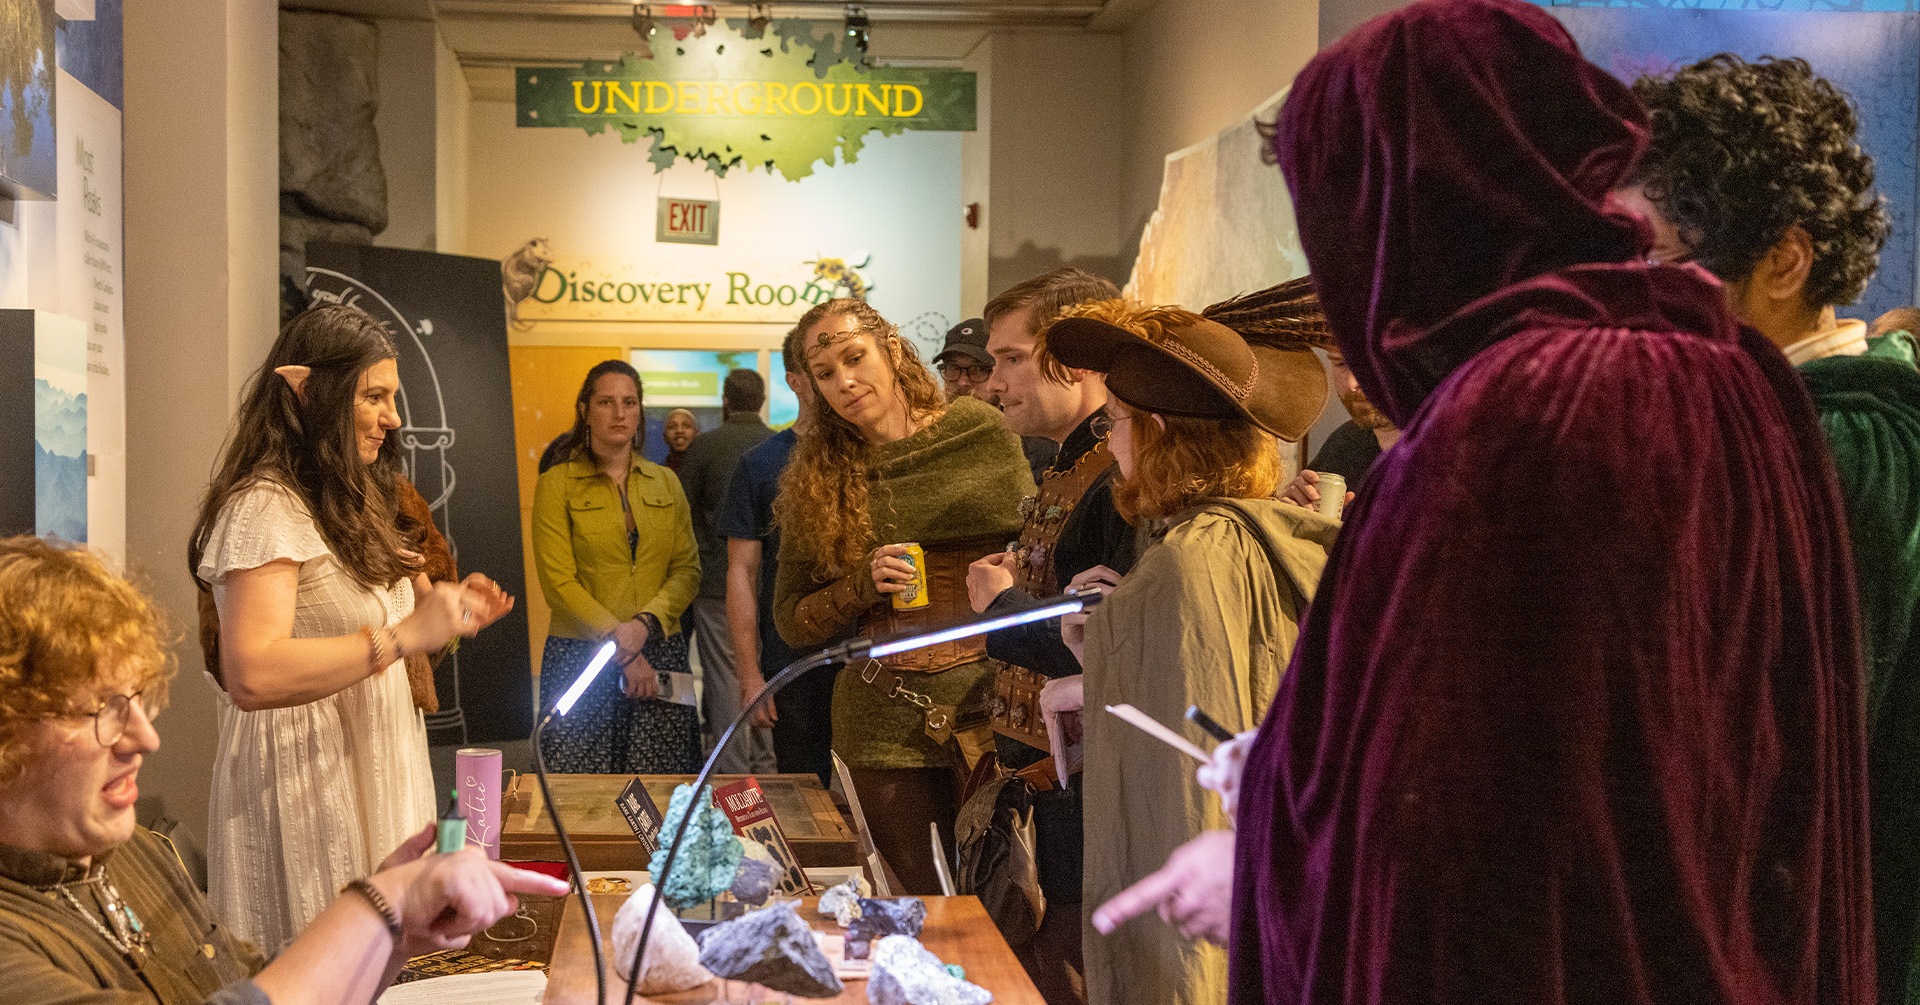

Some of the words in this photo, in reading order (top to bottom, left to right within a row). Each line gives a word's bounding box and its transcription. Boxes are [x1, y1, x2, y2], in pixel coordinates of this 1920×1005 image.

[572, 80, 924, 117] UNDERGROUND
[669, 202, 708, 232] EXIT
[532, 265, 712, 311] Discovery
[725, 272, 833, 306] Room
[465, 781, 494, 851] Katie
[725, 787, 764, 813] MOLDAVITE
[620, 802, 630, 817] RARE
[627, 815, 640, 832] EARTH
